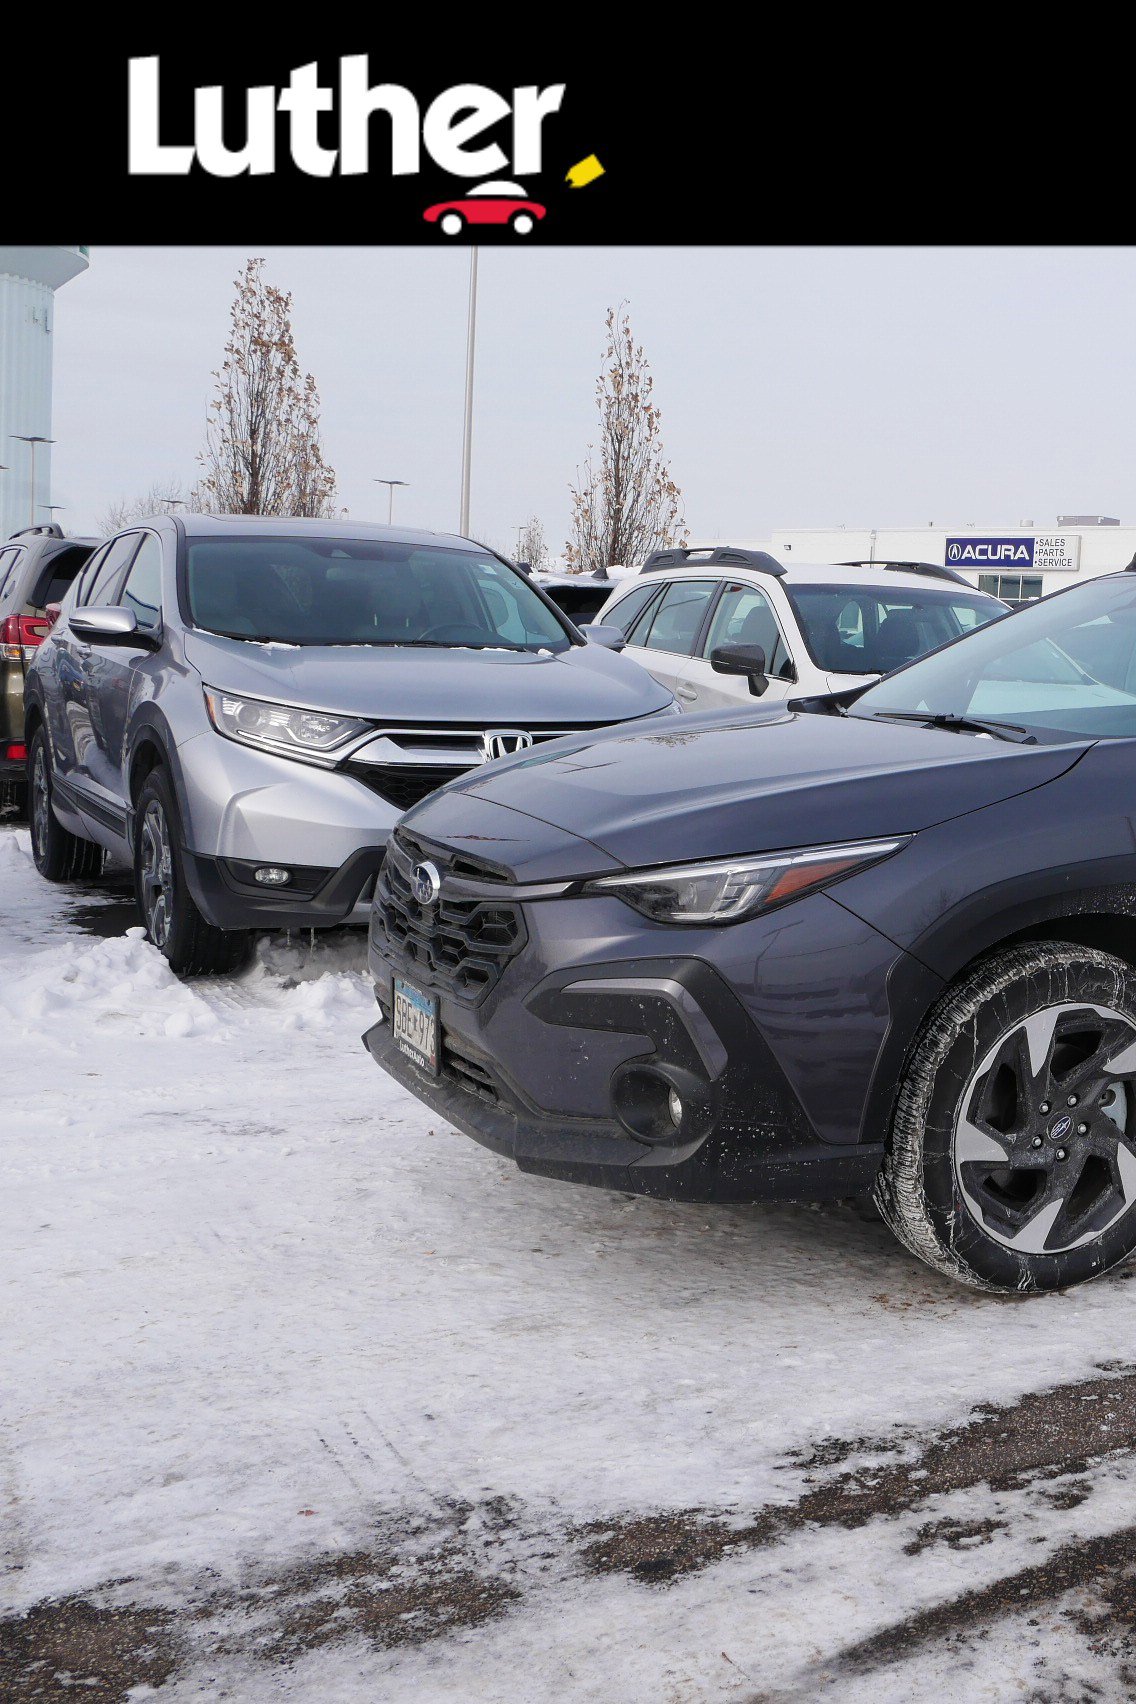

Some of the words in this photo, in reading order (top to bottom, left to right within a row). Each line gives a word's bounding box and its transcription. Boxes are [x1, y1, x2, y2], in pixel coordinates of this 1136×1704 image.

[1038, 539, 1065, 547] SALES
[961, 545, 1029, 560] ACURA
[1038, 549, 1065, 557] PARTS
[1037, 559, 1073, 568] SERVICE
